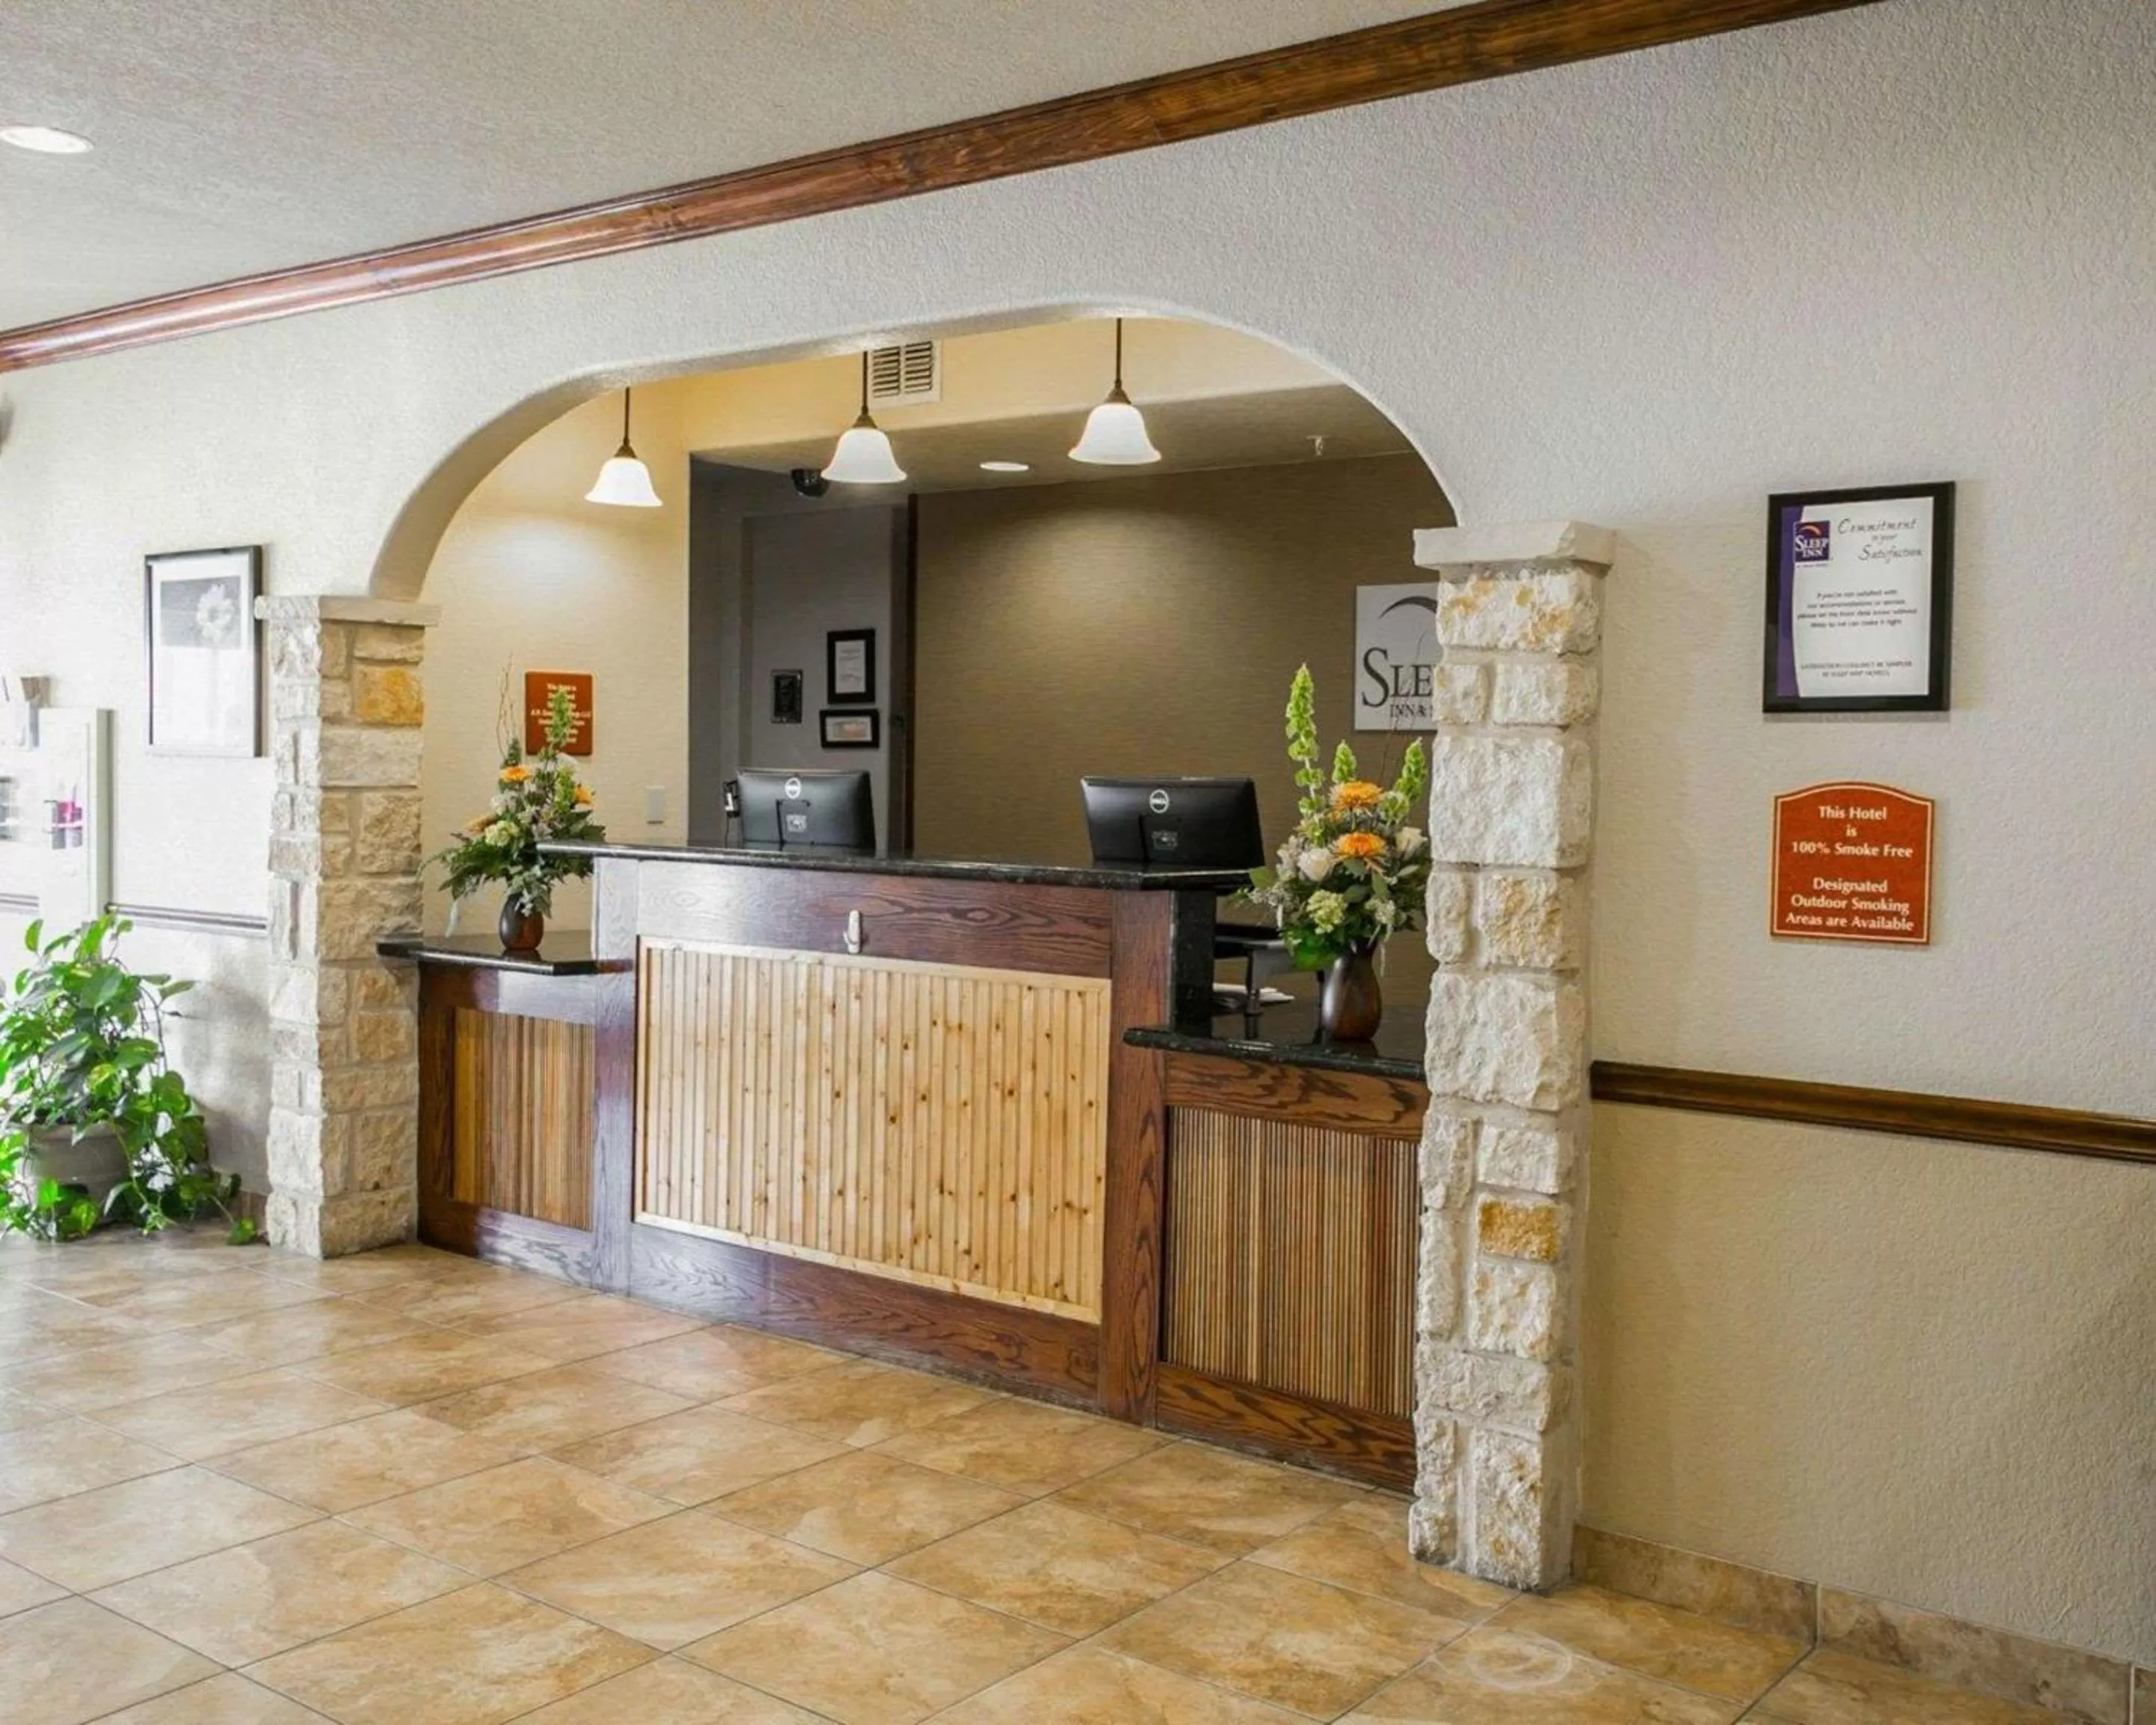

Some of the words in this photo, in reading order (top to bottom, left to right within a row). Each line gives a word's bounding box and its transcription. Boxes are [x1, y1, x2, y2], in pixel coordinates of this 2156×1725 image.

[1838, 518, 1916, 535] Commitment
[1794, 535, 1829, 552] SLEEP
[1802, 549, 1823, 558] INN
[1858, 544, 1922, 564] Satisfaction
[1362, 647, 1436, 708] SLE
[1818, 806, 1845, 819] This
[1849, 807, 1887, 821] Hotel
[1845, 824, 1857, 837] is
[1792, 842, 1831, 854] 100%
[1835, 843, 1880, 857] Smoke
[1883, 845, 1914, 858] Free
[1812, 877, 1888, 895] Designated
[1791, 895, 1848, 910] Outdoor
[1851, 898, 1910, 916] Smoking
[1785, 912, 1823, 925] Areas
[1826, 916, 1848, 927] are
[1852, 916, 1914, 931] Available
